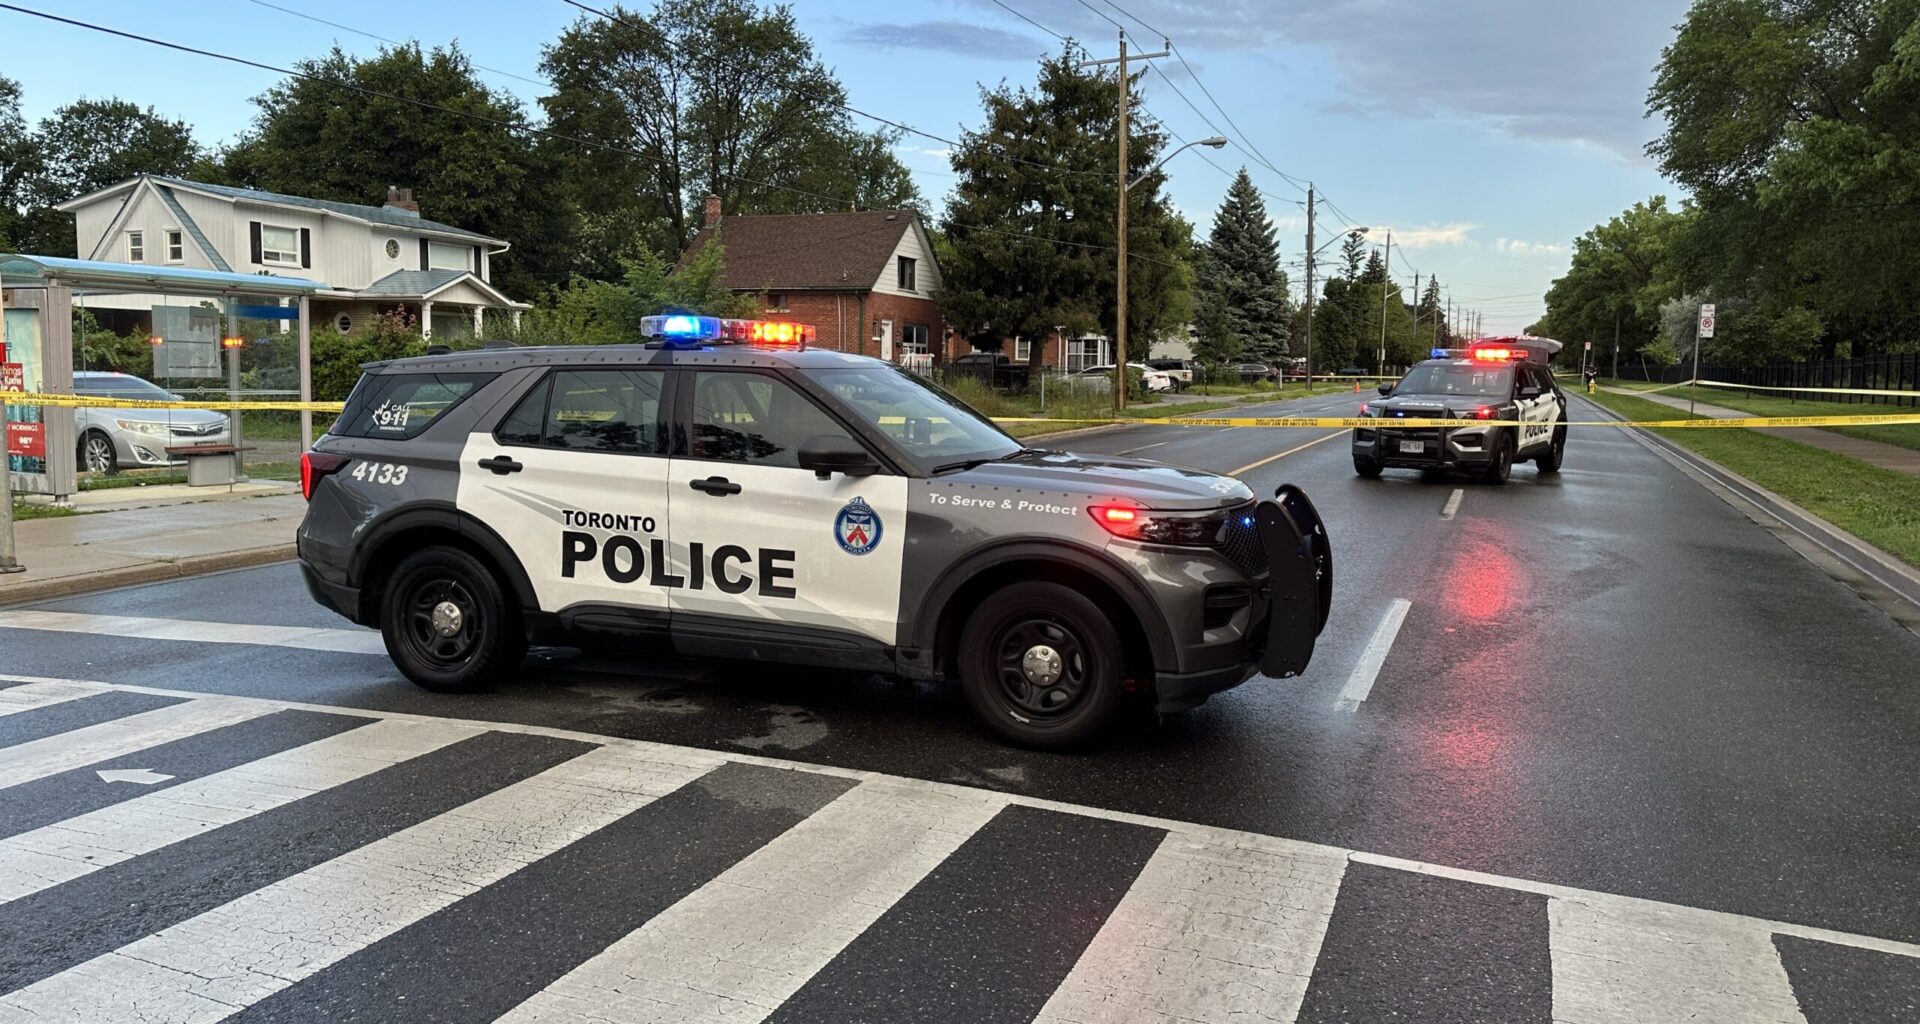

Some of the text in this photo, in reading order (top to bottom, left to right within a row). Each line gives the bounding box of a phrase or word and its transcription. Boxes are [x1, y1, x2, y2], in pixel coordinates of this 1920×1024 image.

[351, 461, 409, 486] 4133
[929, 493, 1078, 516] To Serve & Protect
[562, 510, 656, 533] TORONTO
[561, 530, 797, 600] POLICE
